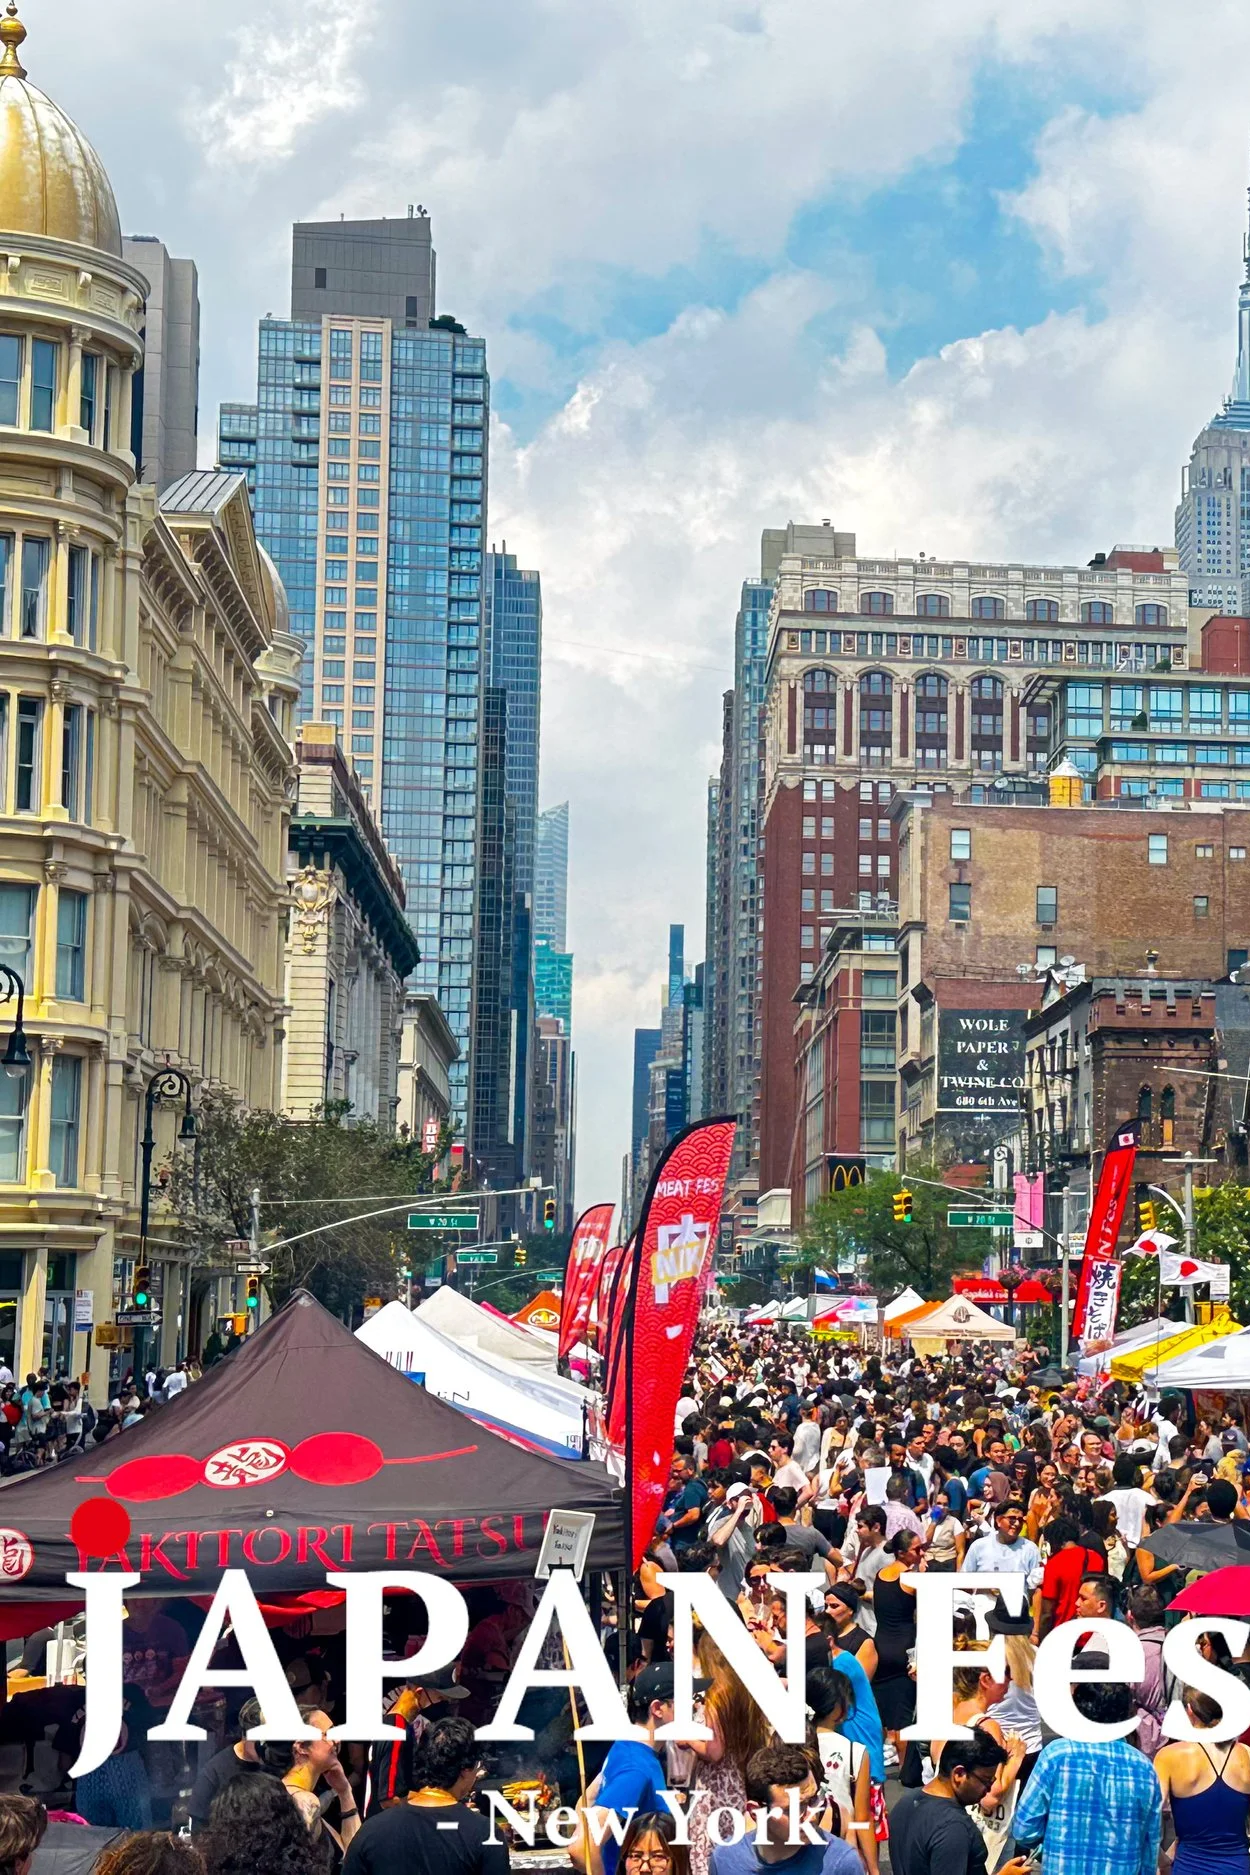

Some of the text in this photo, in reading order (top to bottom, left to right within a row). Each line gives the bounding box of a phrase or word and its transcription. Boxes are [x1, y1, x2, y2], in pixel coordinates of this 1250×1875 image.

[957, 1041, 1009, 1054] PAPER
[976, 1059, 989, 1071] &
[940, 1076, 996, 1088] TWINE
[956, 1096, 975, 1106] 680
[654, 1176, 720, 1198] MEAT FES
